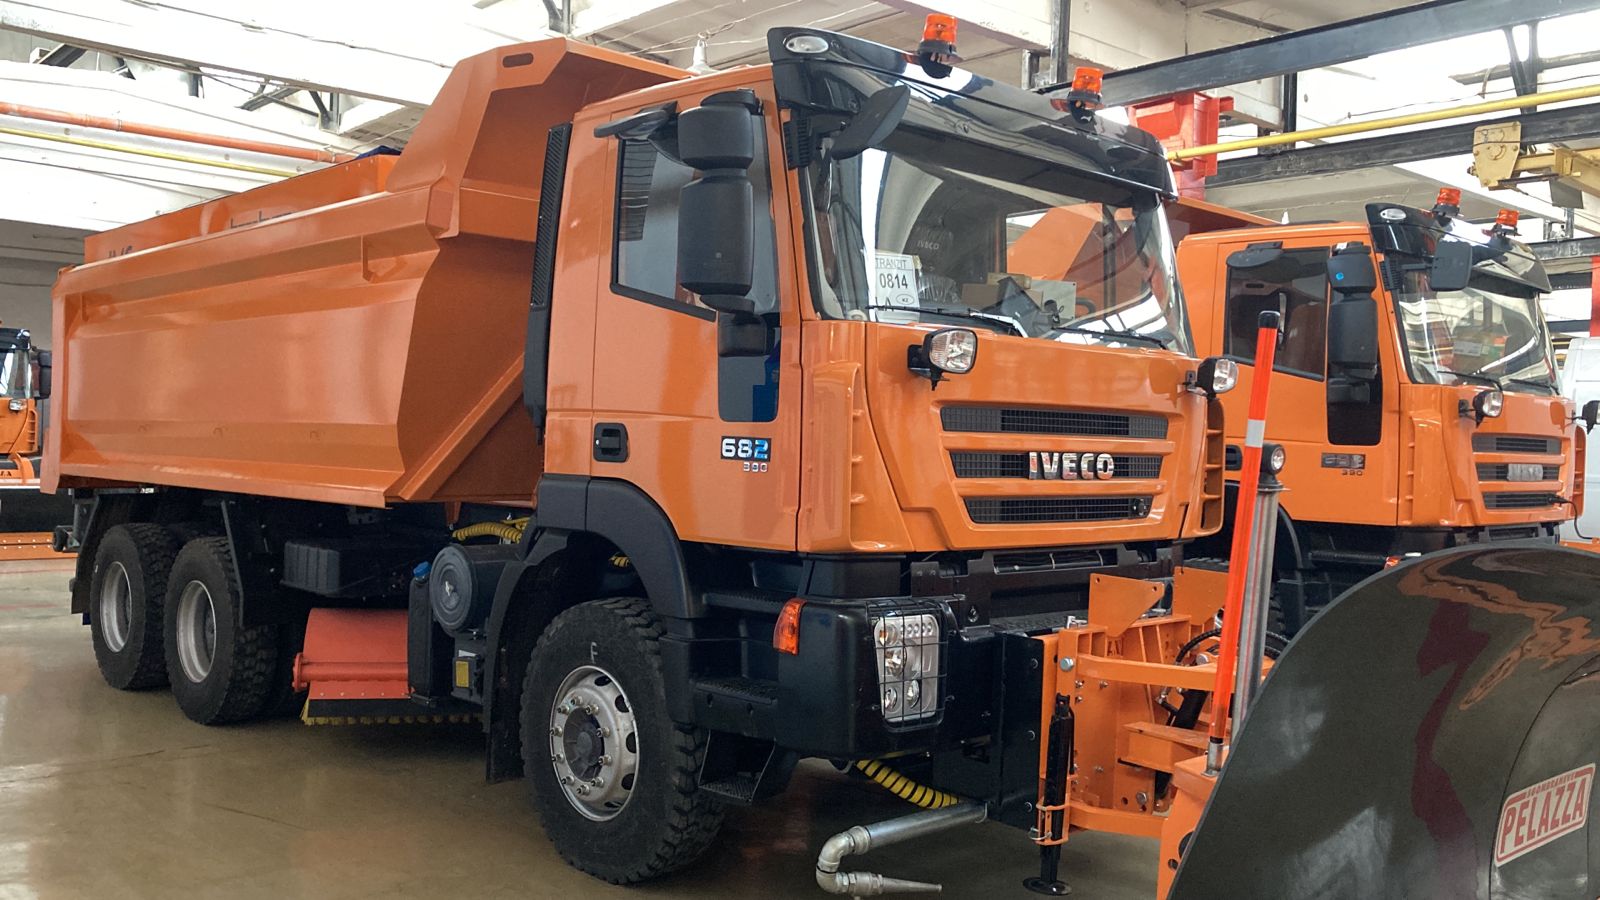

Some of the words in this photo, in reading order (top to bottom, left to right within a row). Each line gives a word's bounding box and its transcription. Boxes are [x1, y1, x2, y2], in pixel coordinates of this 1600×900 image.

[875, 257, 906, 269] TRANZIT
[879, 272, 908, 289] 0814
[722, 438, 768, 459] 682
[743, 461, 767, 472] 390
[1028, 451, 1114, 480] IVECO
[1500, 777, 1587, 855] PELAZZA
